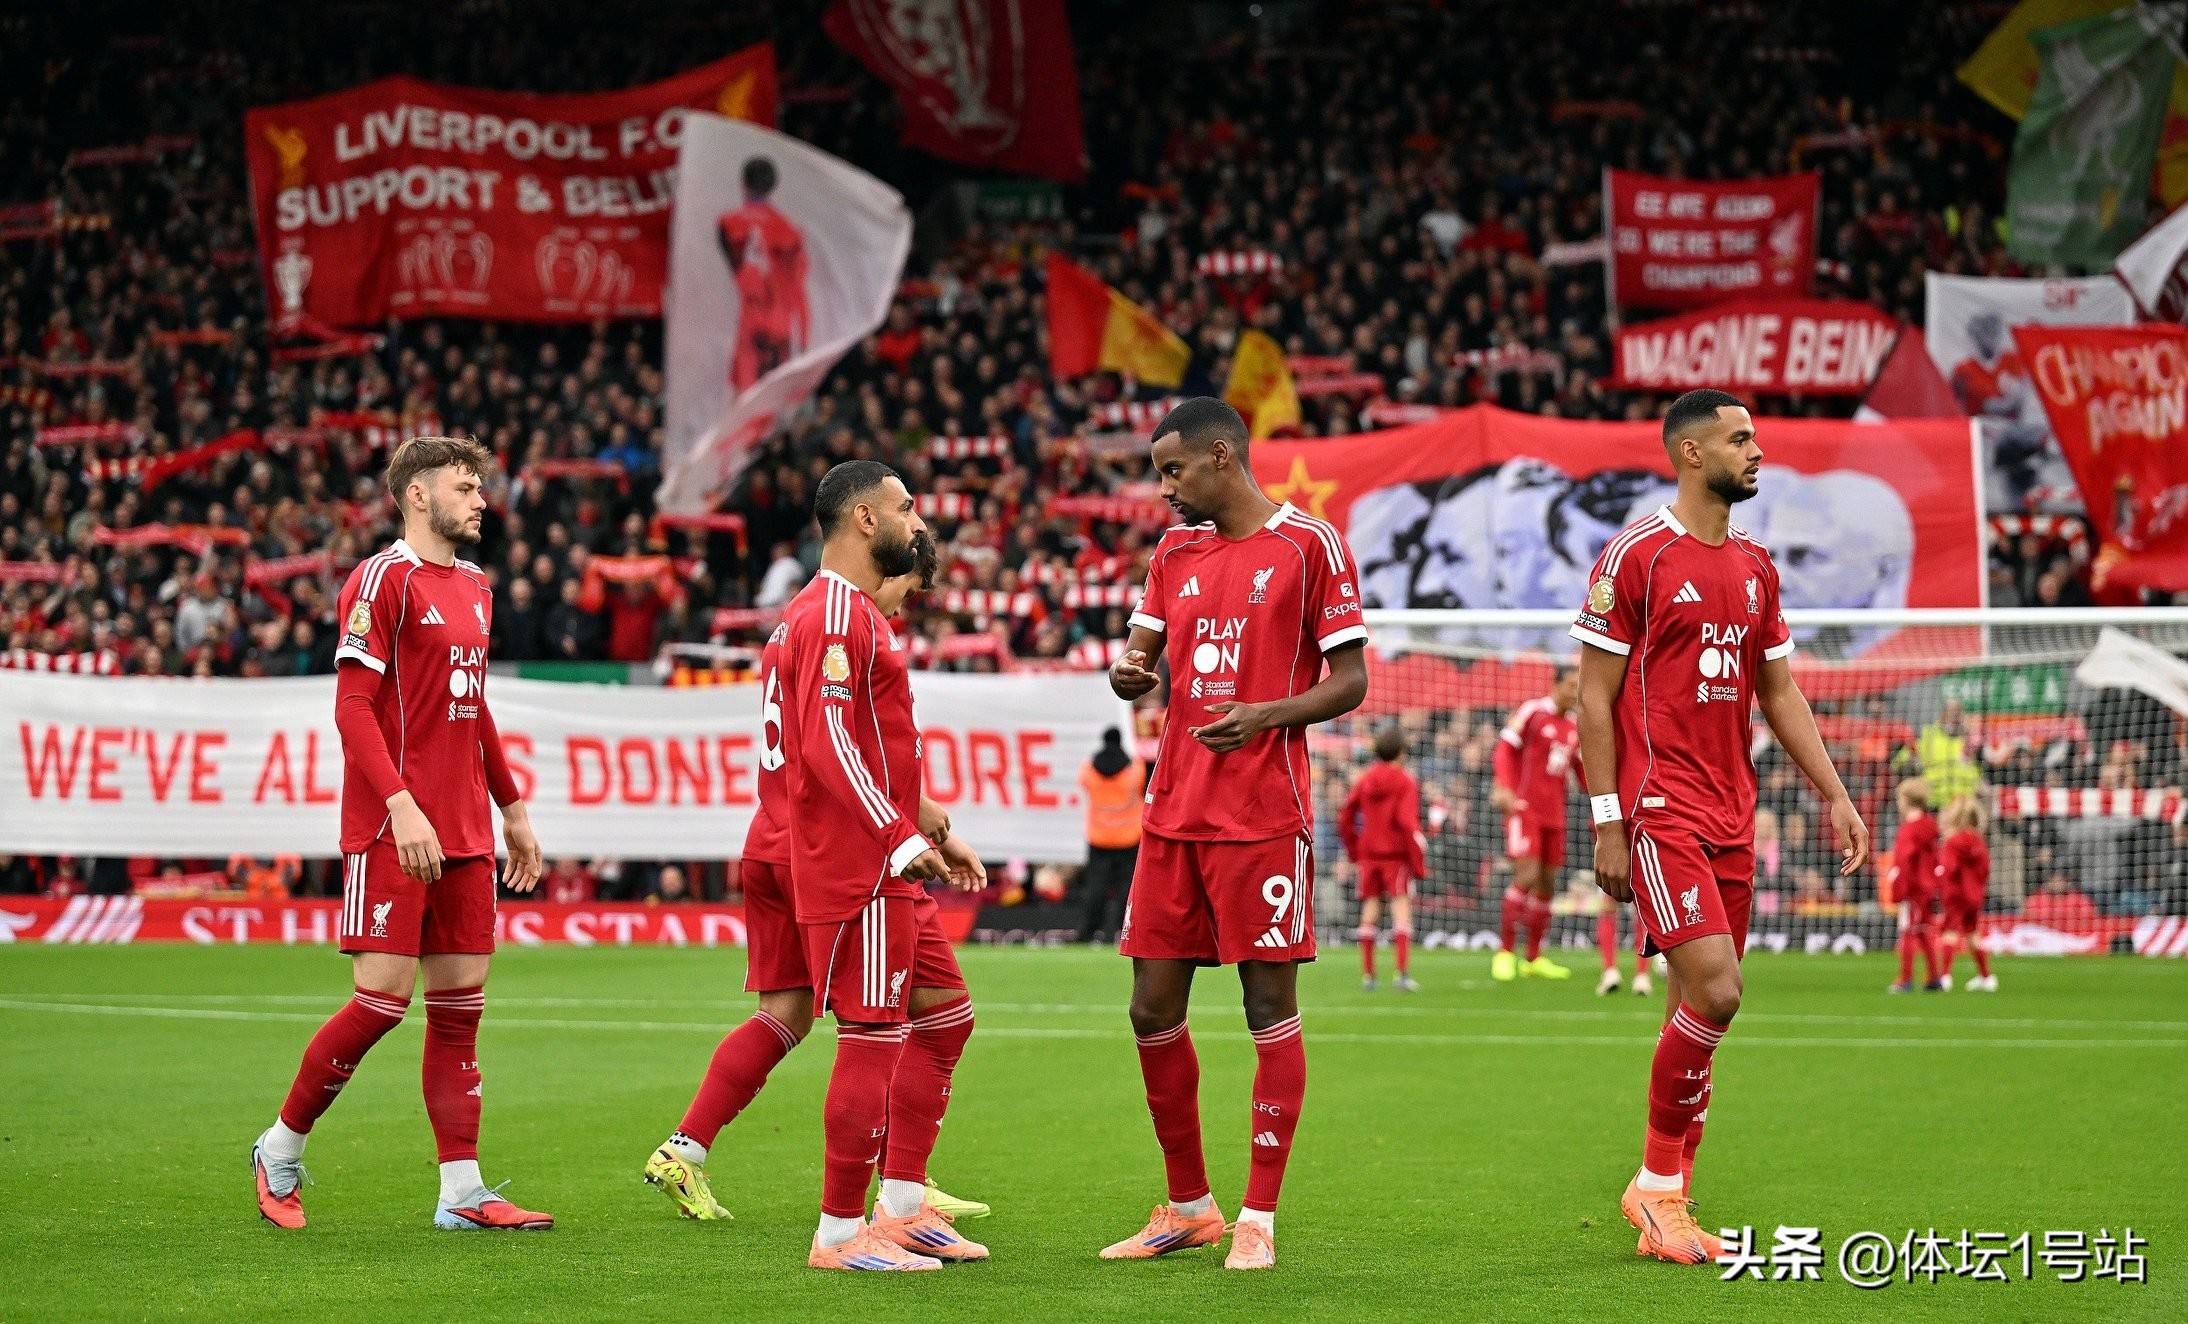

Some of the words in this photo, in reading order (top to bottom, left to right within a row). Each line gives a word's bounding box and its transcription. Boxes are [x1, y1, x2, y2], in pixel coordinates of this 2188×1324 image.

[334, 102, 608, 163] LIVERPOOL
[275, 165, 500, 232] SUPPORT
[515, 174, 553, 213] &
[1621, 313, 1783, 388] IMAGINE
[1196, 617, 1249, 641] PLAY
[1701, 622, 1749, 646] PLAY
[450, 645, 486, 667] PLAY
[1192, 642, 1241, 674] ON
[1698, 647, 1741, 680] ON
[450, 668, 483, 699] ON
[18, 722, 227, 803] WE'VE
[565, 735, 755, 806] DONE
[1261, 874, 1294, 923] 9
